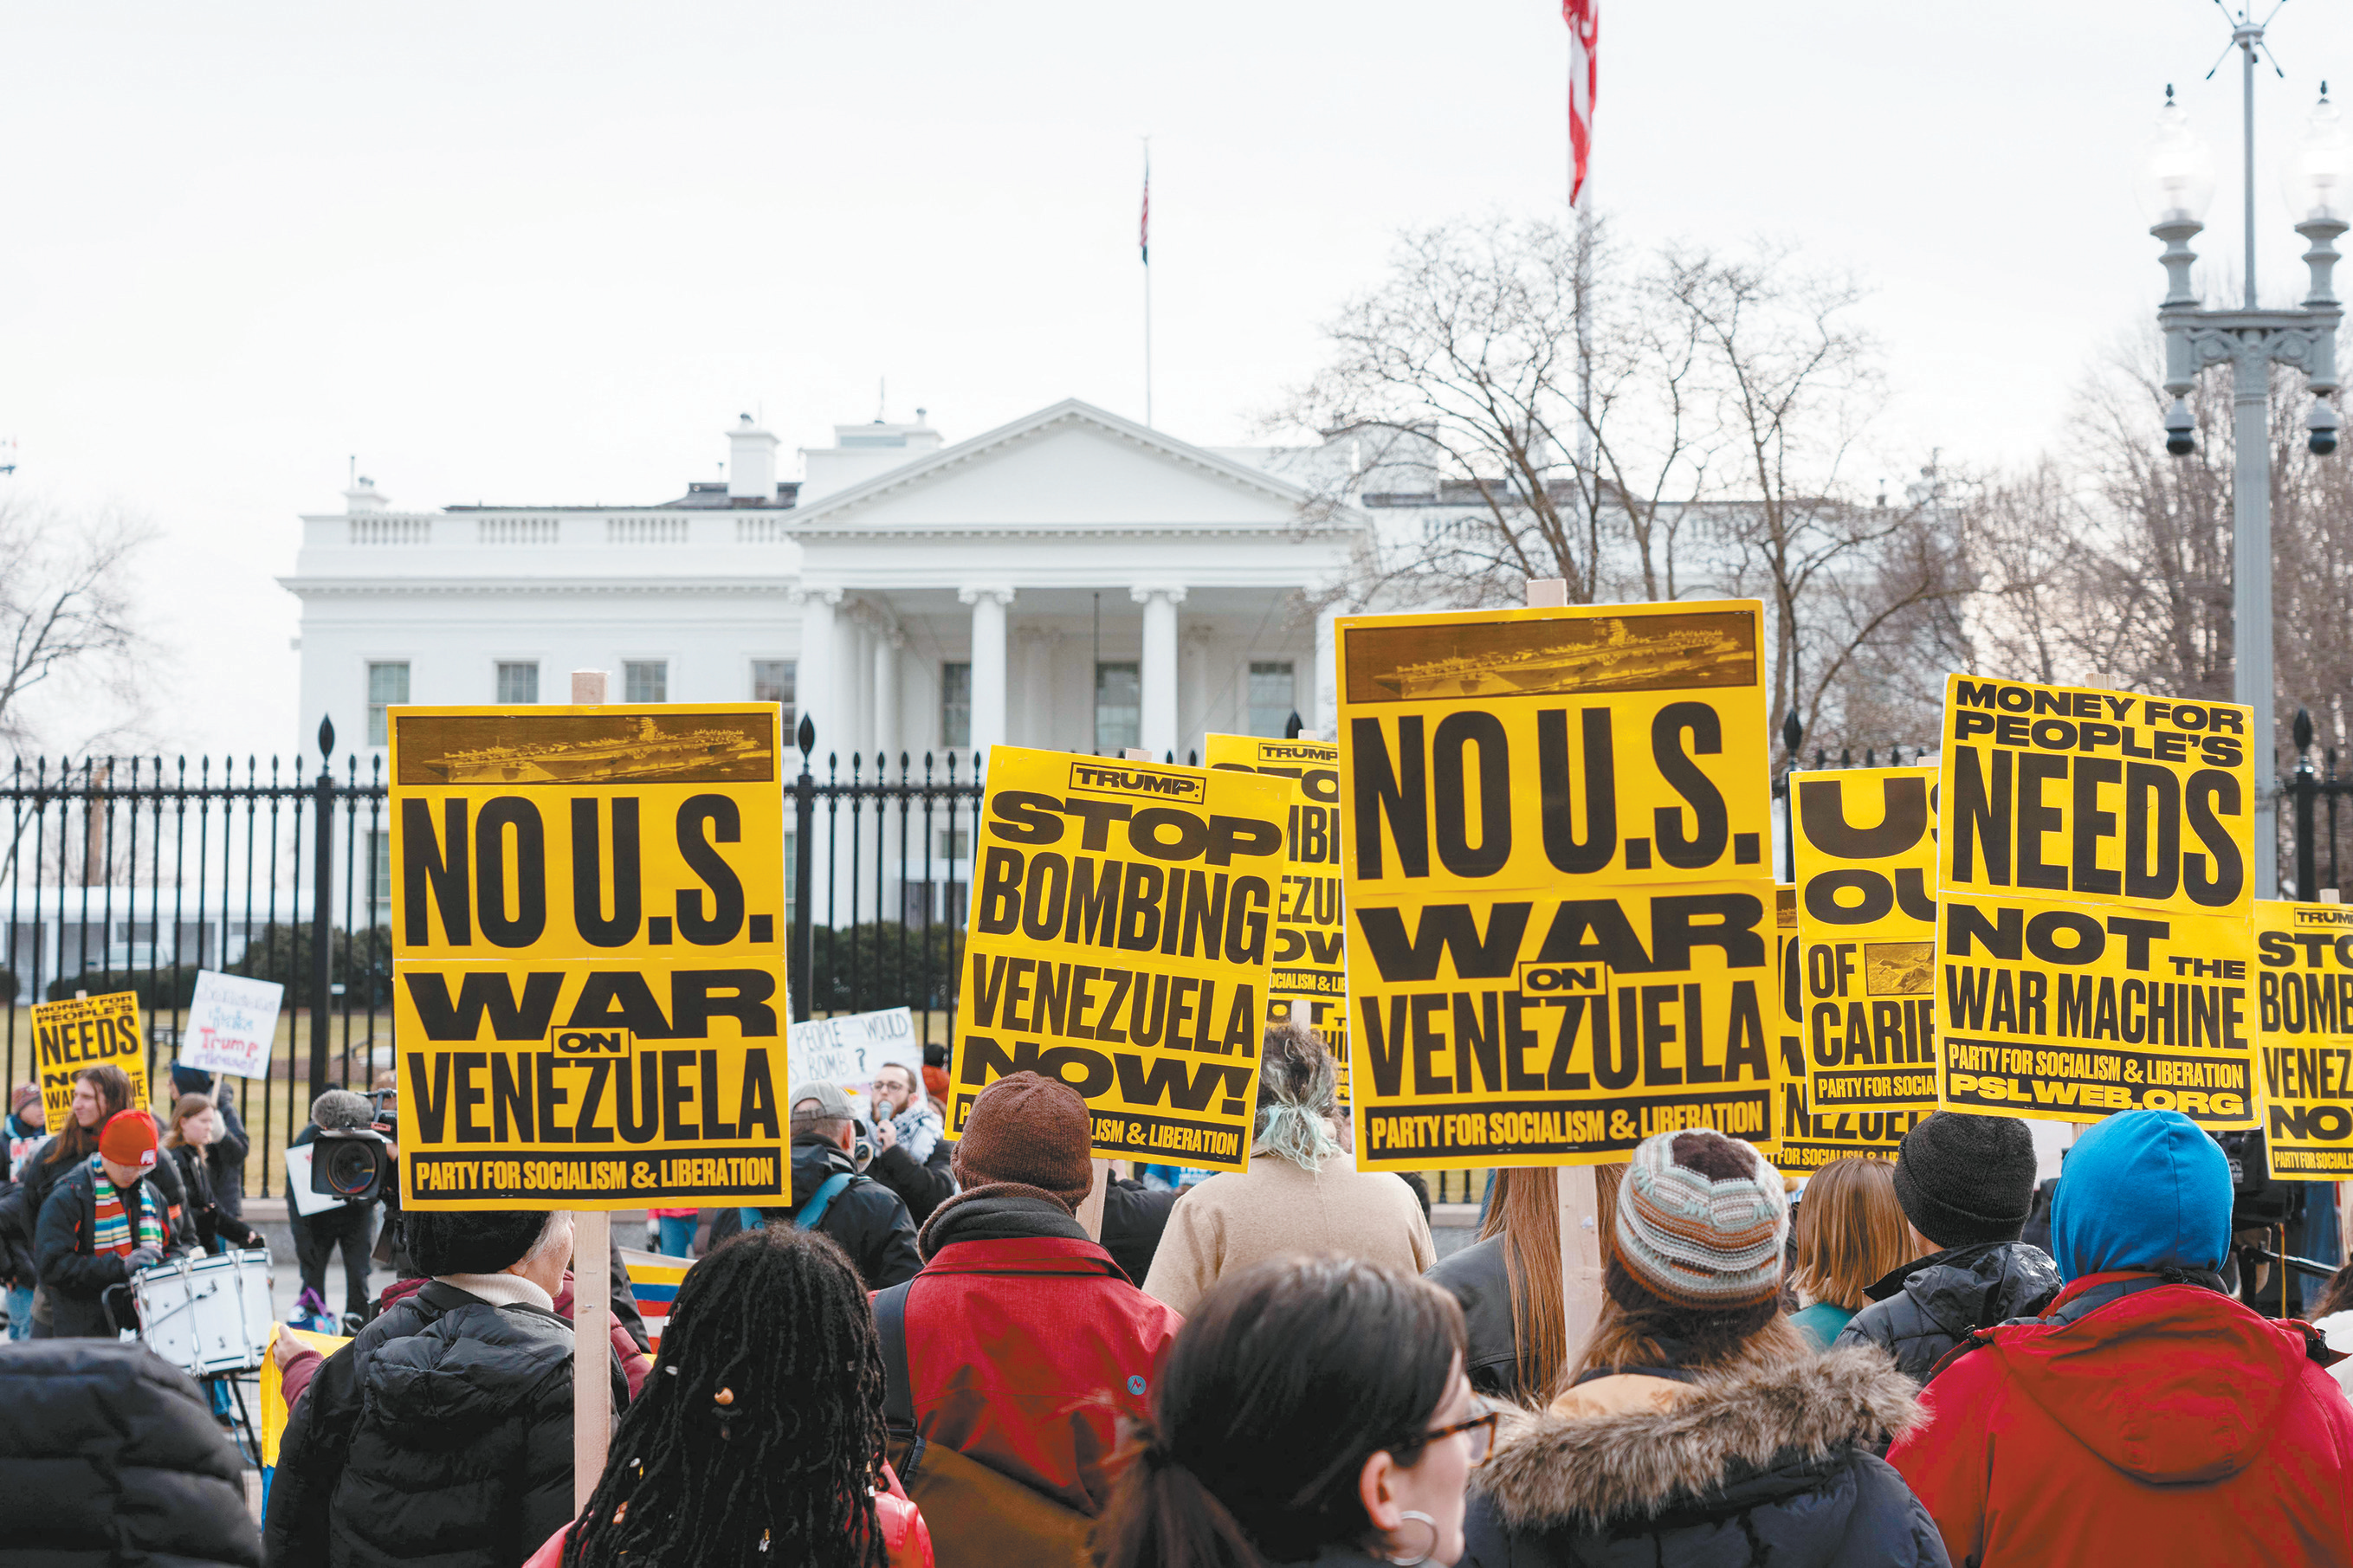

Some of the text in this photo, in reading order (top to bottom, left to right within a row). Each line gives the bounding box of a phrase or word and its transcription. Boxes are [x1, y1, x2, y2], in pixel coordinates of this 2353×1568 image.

[1955, 681, 2244, 734] MONEY FOR
[1955, 710, 2244, 767] PEOPLE'S
[1074, 769, 1200, 798] TRUMP:
[1350, 701, 1761, 880] NO U.S.
[988, 790, 1282, 867] STOP
[1952, 745, 2244, 907] NEEDS
[401, 793, 773, 948] NO U.S.
[978, 846, 1270, 966] BOMBING
[2297, 912, 2353, 924] TRUM
[1354, 893, 1767, 983] WAR
[1946, 905, 2170, 971] NOT
[1270, 973, 1316, 991] OCIALISM
[1317, 976, 1331, 992] &
[1526, 967, 1597, 991] ON
[1807, 942, 1857, 999] OF
[2169, 956, 2246, 980] THE
[36, 996, 133, 1014] MONEY FOR
[37, 1004, 133, 1023] PEOPLE'S
[404, 968, 779, 1042] WAR
[973, 953, 1255, 1058] VENEZUELA
[1945, 965, 2248, 1050] WAR MACHINE
[2259, 971, 2353, 1034] BOMB
[39, 1015, 139, 1067] NEEDS
[200, 1026, 258, 1057] Trump
[557, 1032, 622, 1054] ON
[797, 1021, 844, 1052] PEOPLE
[1359, 979, 1772, 1097] VENEZUELA
[960, 1036, 1253, 1115] NOW!
[1818, 1078, 1862, 1099] PARTY
[1864, 1076, 1892, 1097] FOR
[1949, 1043, 2244, 1088] PARTY FOR SOCIALISM & LIBERATION
[2262, 1048, 2353, 1100] VENEZ
[46, 1089, 74, 1110] WA
[407, 1048, 781, 1145] VENEZUELA
[1950, 1073, 2245, 1115] PSLWEB.ORG
[1126, 1122, 1147, 1145] &
[1148, 1124, 1238, 1156] LIBERATION
[1371, 1115, 1441, 1150] PARTY
[1444, 1113, 1488, 1146] FOR
[1489, 1109, 1606, 1145] SOCIALISM
[1609, 1108, 1638, 1140] &
[1640, 1100, 1763, 1138] LIBERATION
[2268, 1105, 2353, 1140] NO
[417, 1157, 773, 1191] PARTY FOR SOCIALISM & LIBERATION
[2274, 1151, 2353, 1170] PARTY FOR SOCIALI
